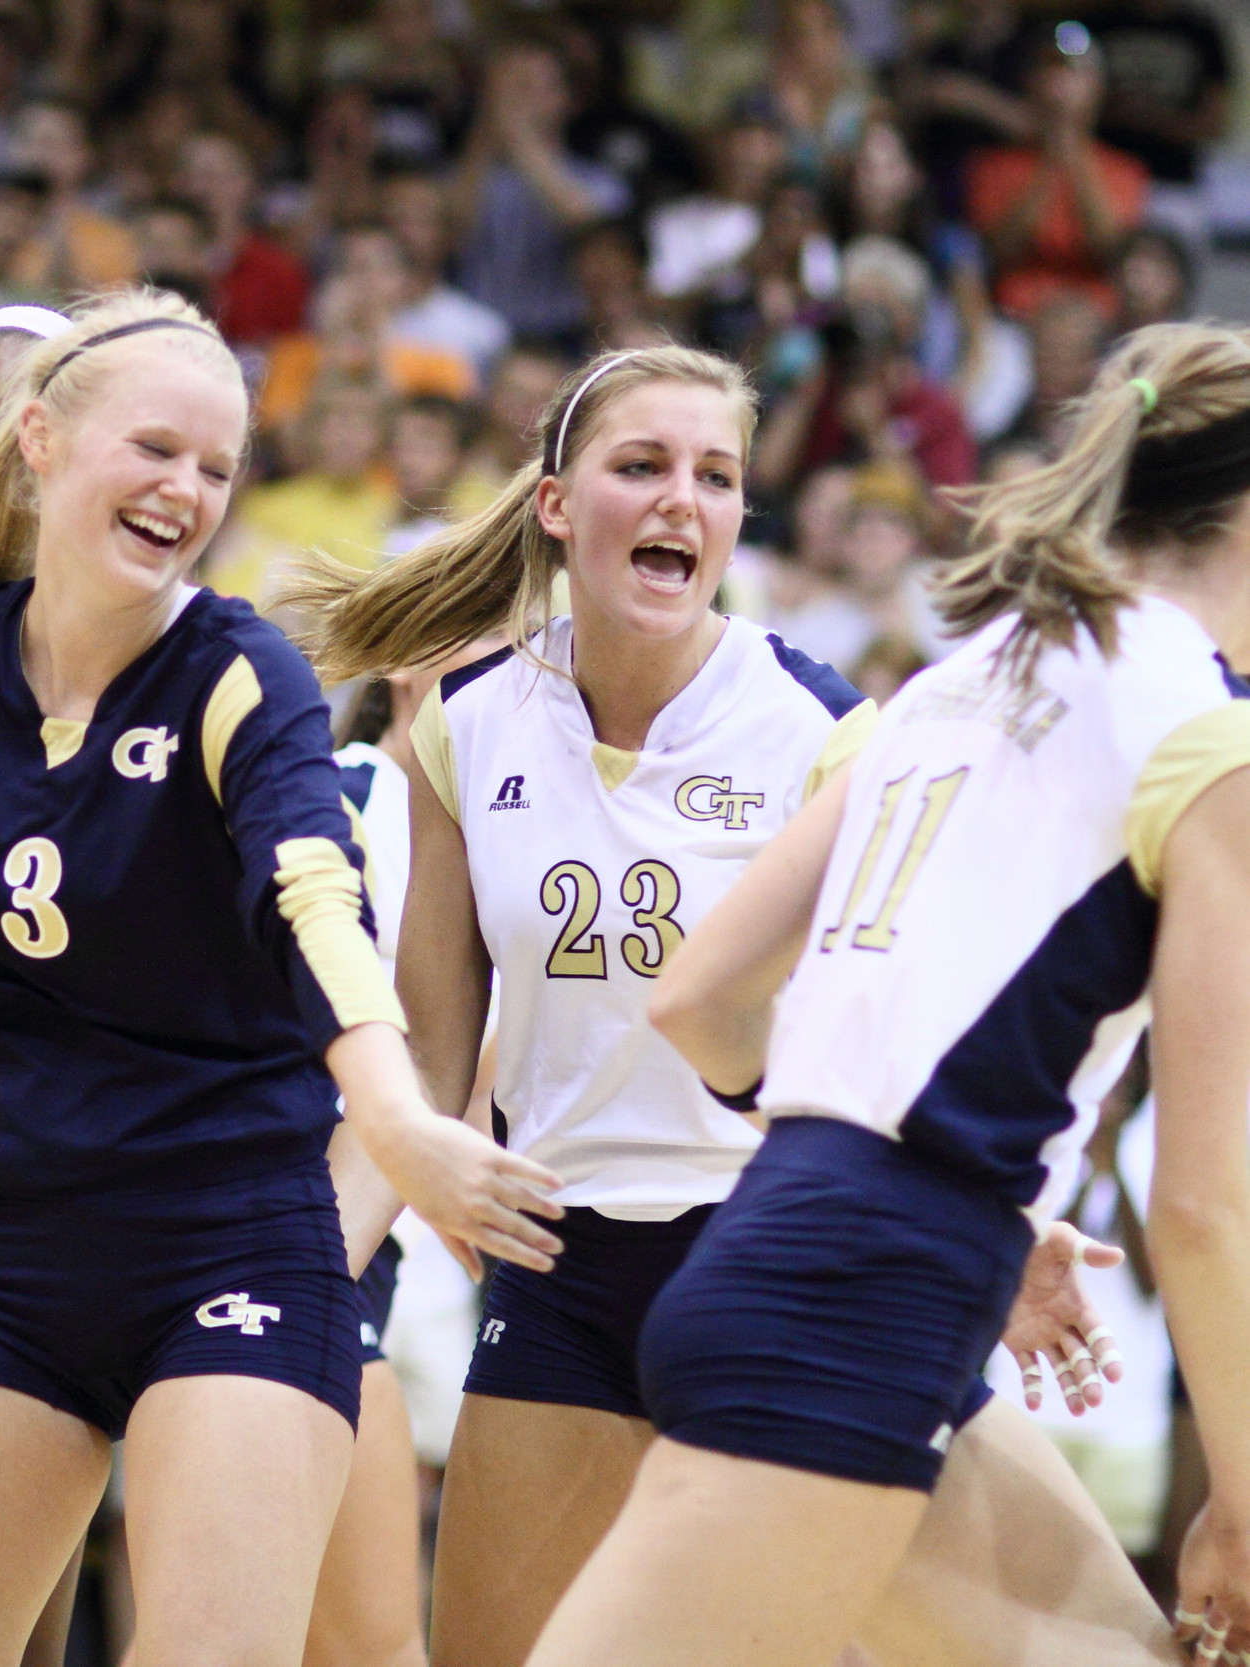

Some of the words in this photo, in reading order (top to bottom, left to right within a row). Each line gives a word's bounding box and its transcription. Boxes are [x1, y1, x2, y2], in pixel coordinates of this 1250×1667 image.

[488, 799, 531, 812] RUSSELL
[674, 775, 765, 830] GT
[0, 836, 69, 959] 3
[819, 764, 972, 953] 11
[540, 858, 686, 981] 23
[482, 1318, 506, 1344] R
